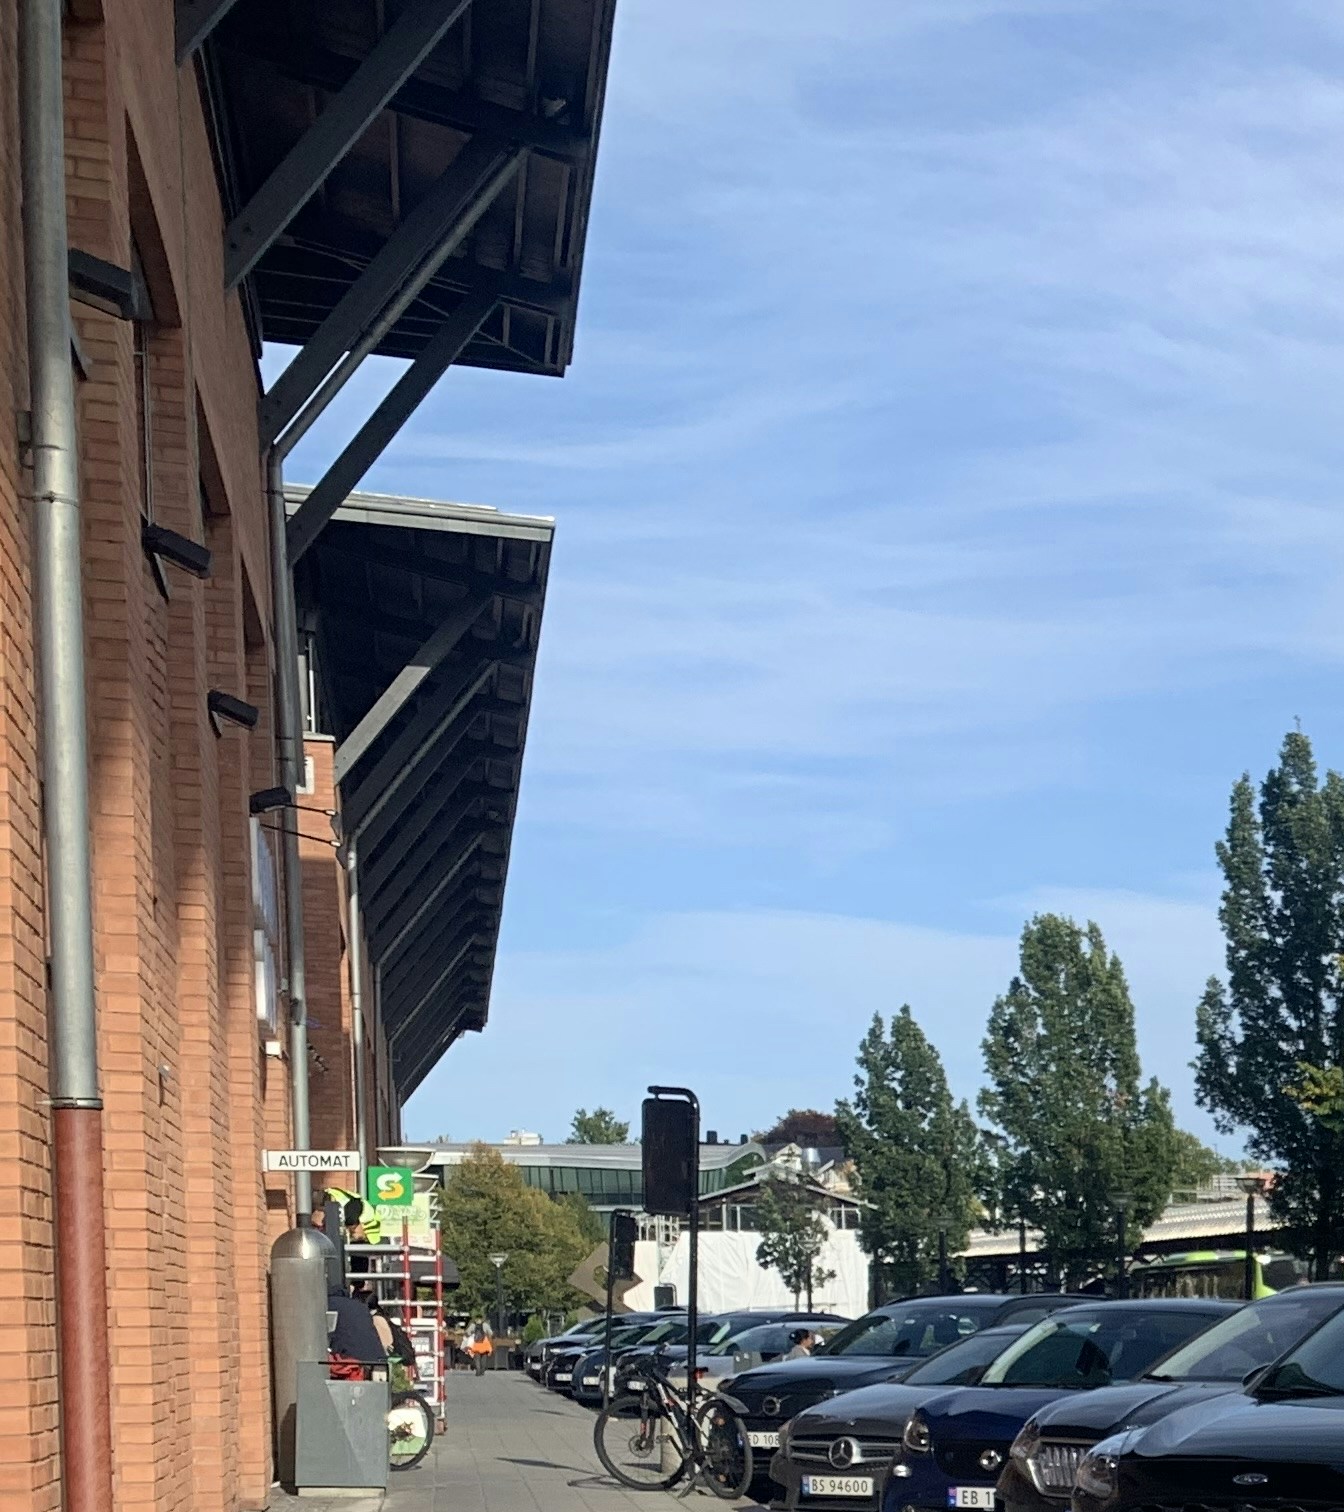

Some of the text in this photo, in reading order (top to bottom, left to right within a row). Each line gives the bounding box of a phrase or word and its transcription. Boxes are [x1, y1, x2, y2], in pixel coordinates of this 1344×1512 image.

[278, 1155, 351, 1168] AUTOMAT
[812, 1478, 868, 1493] BS 94600
[962, 1490, 979, 1505] EB
